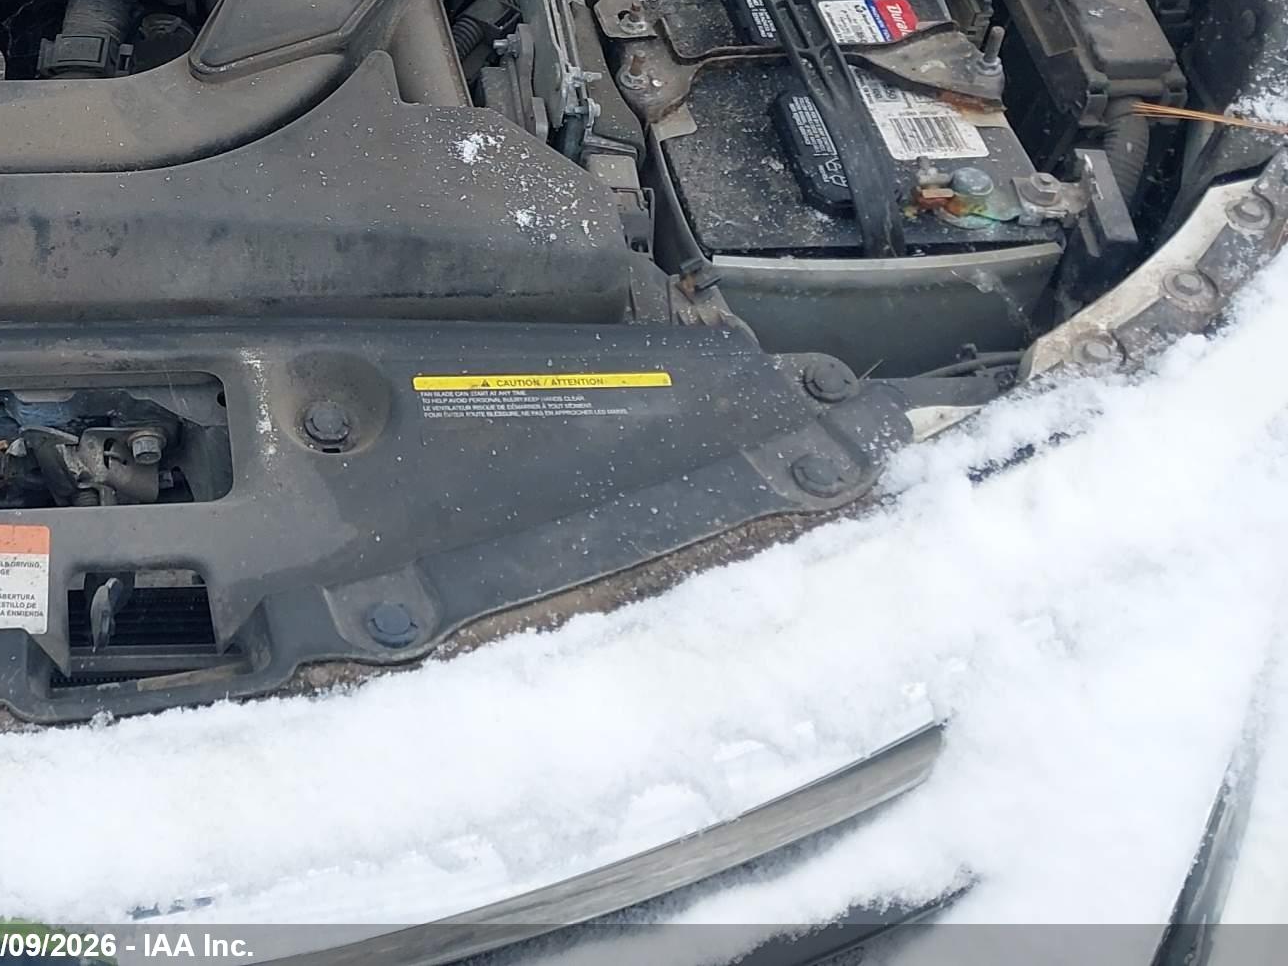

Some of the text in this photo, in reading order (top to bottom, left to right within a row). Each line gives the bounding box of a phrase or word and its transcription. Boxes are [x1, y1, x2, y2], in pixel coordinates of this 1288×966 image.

[886, 3, 912, 37] Dural
[496, 379, 540, 387] CAUTION
[551, 377, 604, 386] ATTENTION
